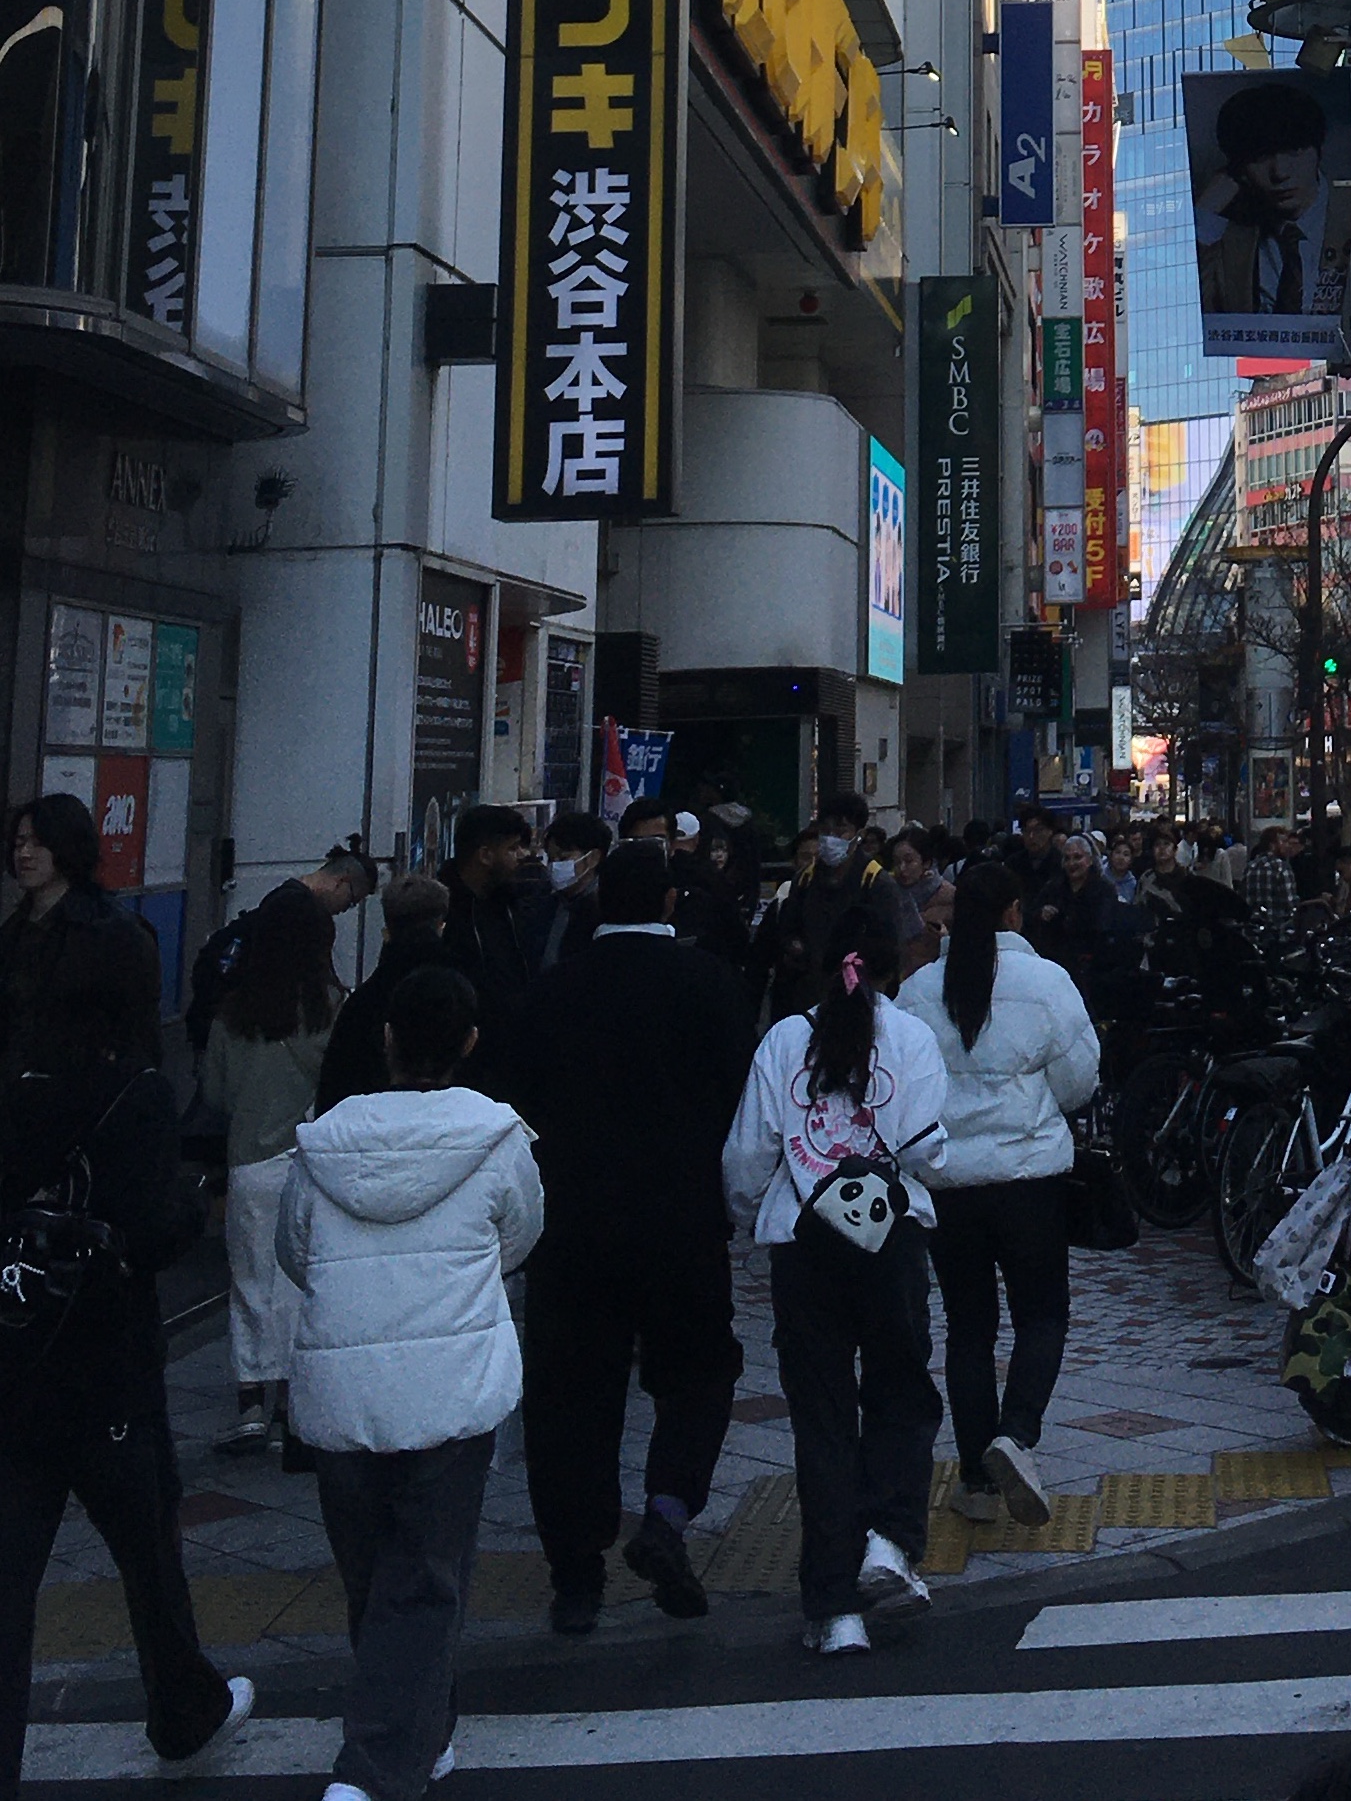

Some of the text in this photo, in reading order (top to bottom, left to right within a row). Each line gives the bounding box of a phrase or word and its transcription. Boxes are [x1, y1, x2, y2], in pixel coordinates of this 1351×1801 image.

[1008, 132, 1046, 199] A2
[1081, 101, 1106, 392] カラオケ歌広場
[541, 166, 630, 496] 渋谷本店
[1054, 323, 1072, 394] 宝石広場
[948, 336, 971, 436] SMBC
[937, 457, 952, 585] PRESTIA
[960, 457, 980, 584] 三井住友銀行
[1051, 523, 1078, 536] ¥200
[1053, 538, 1076, 551] BAR
